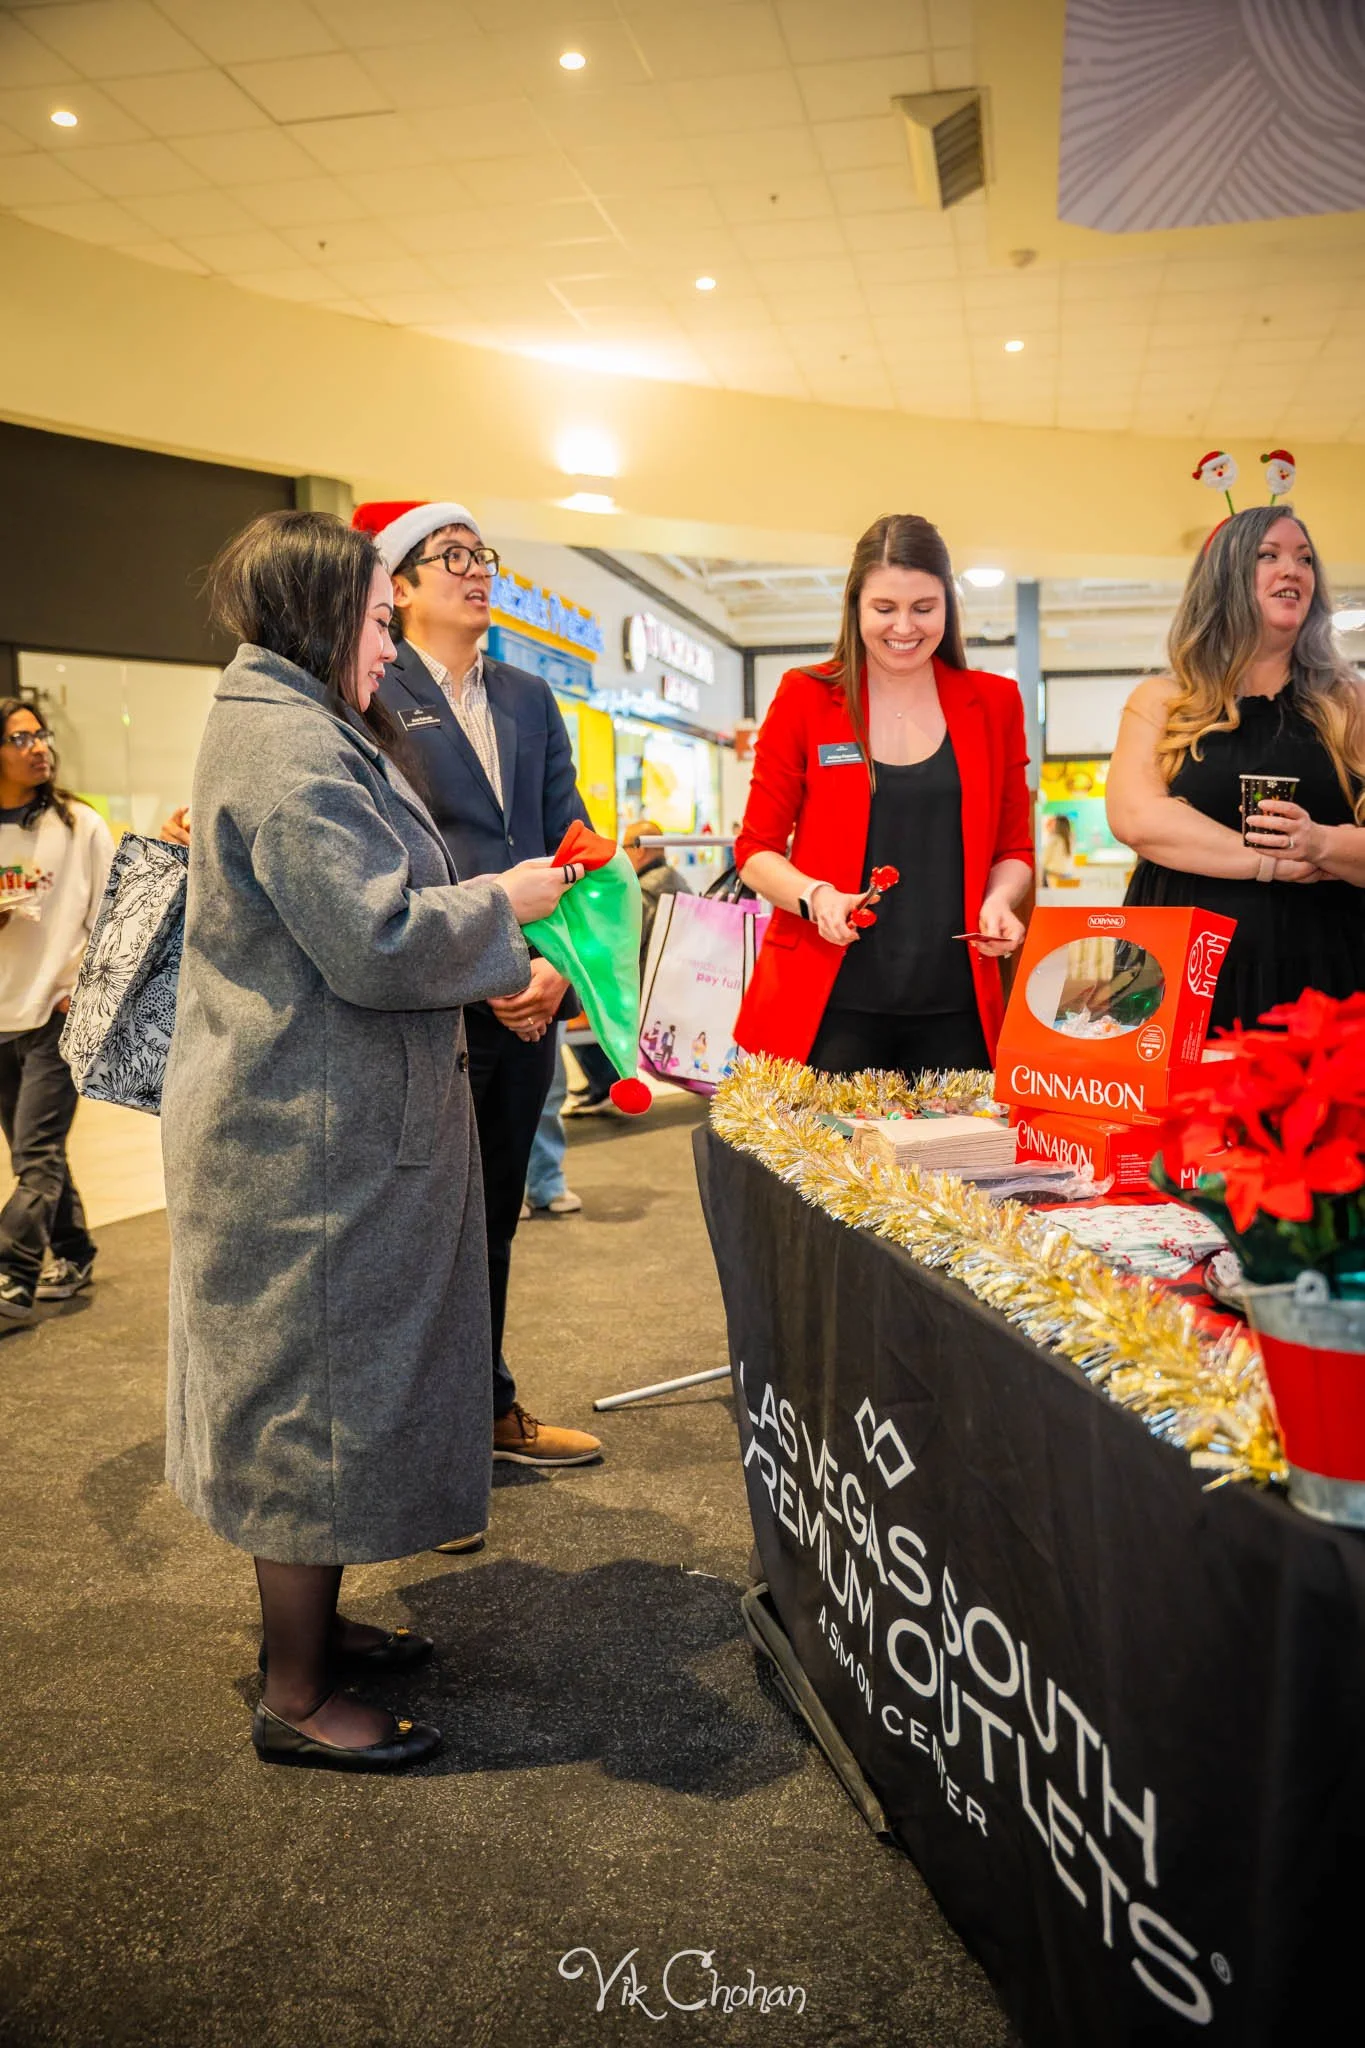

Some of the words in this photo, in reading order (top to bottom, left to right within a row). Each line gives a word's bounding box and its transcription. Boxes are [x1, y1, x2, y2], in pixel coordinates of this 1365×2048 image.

[696, 972, 718, 987] pay
[1011, 1065, 1145, 1112] CINNABON
[1016, 1119, 1093, 1168] CINNABON
[740, 1360, 798, 1464] LAS
[801, 1420, 932, 1607] VEGAS
[941, 1566, 1160, 1889] SOUTH
[818, 1604, 828, 1633] A
[829, 1630, 873, 1716] SIMON
[881, 1704, 989, 1838] CENTER
